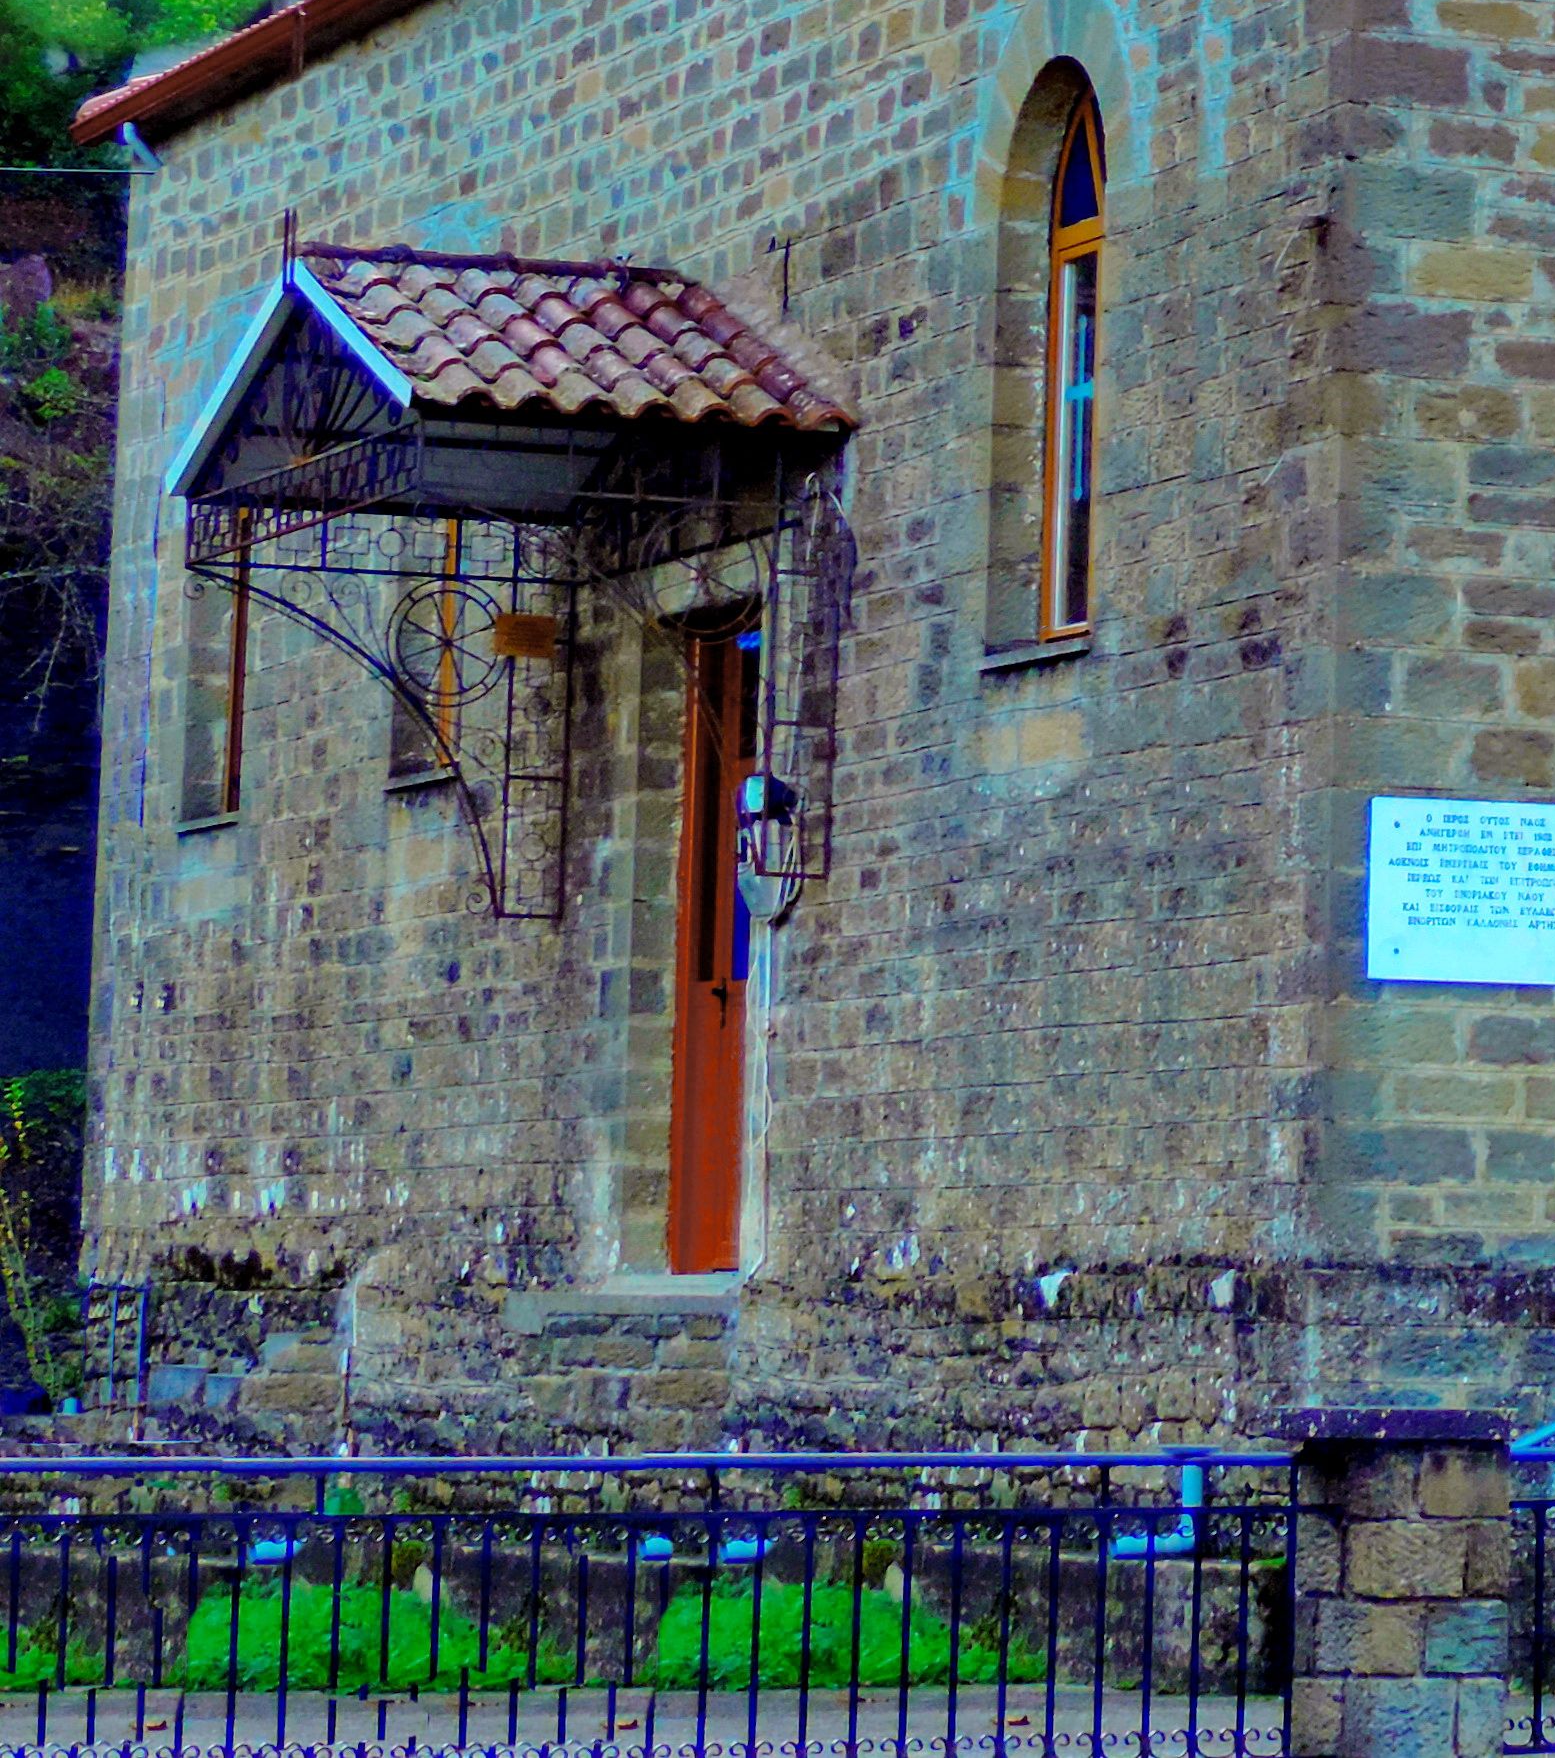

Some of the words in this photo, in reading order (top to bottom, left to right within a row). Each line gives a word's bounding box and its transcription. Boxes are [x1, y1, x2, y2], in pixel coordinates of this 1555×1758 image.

[1426, 814, 1432, 823] Ο
[1500, 861, 1517, 870] ΤΟΥ
[1425, 889, 1443, 897] ΤΟΥ
[1403, 903, 1419, 911] ΚΑΙ
